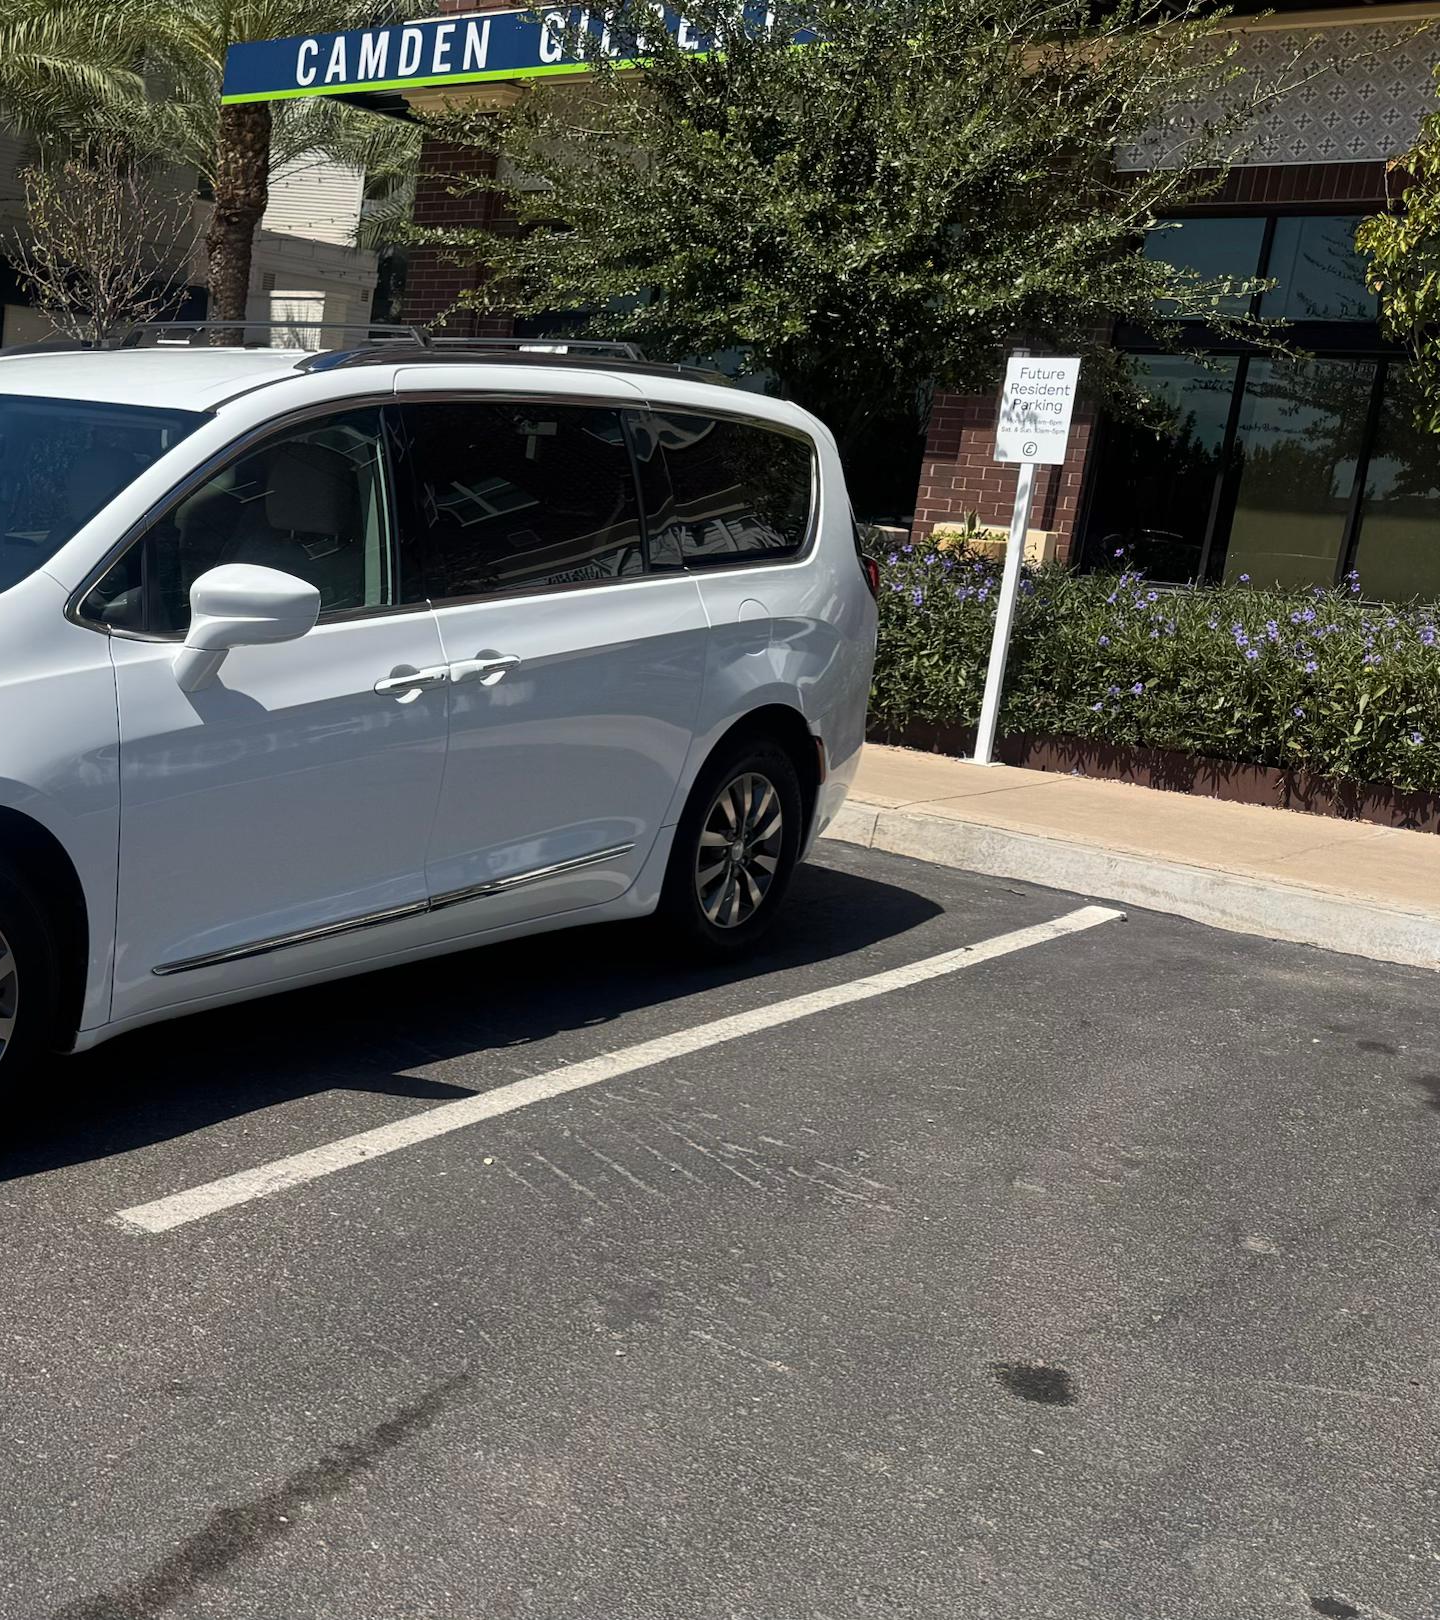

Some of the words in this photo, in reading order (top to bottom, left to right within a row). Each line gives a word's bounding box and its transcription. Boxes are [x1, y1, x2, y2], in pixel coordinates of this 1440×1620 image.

[296, 20, 491, 87] CAMDEN
[1020, 367, 1066, 380] Future
[1010, 382, 1071, 396] Resident
[1012, 398, 1063, 414] Parking
